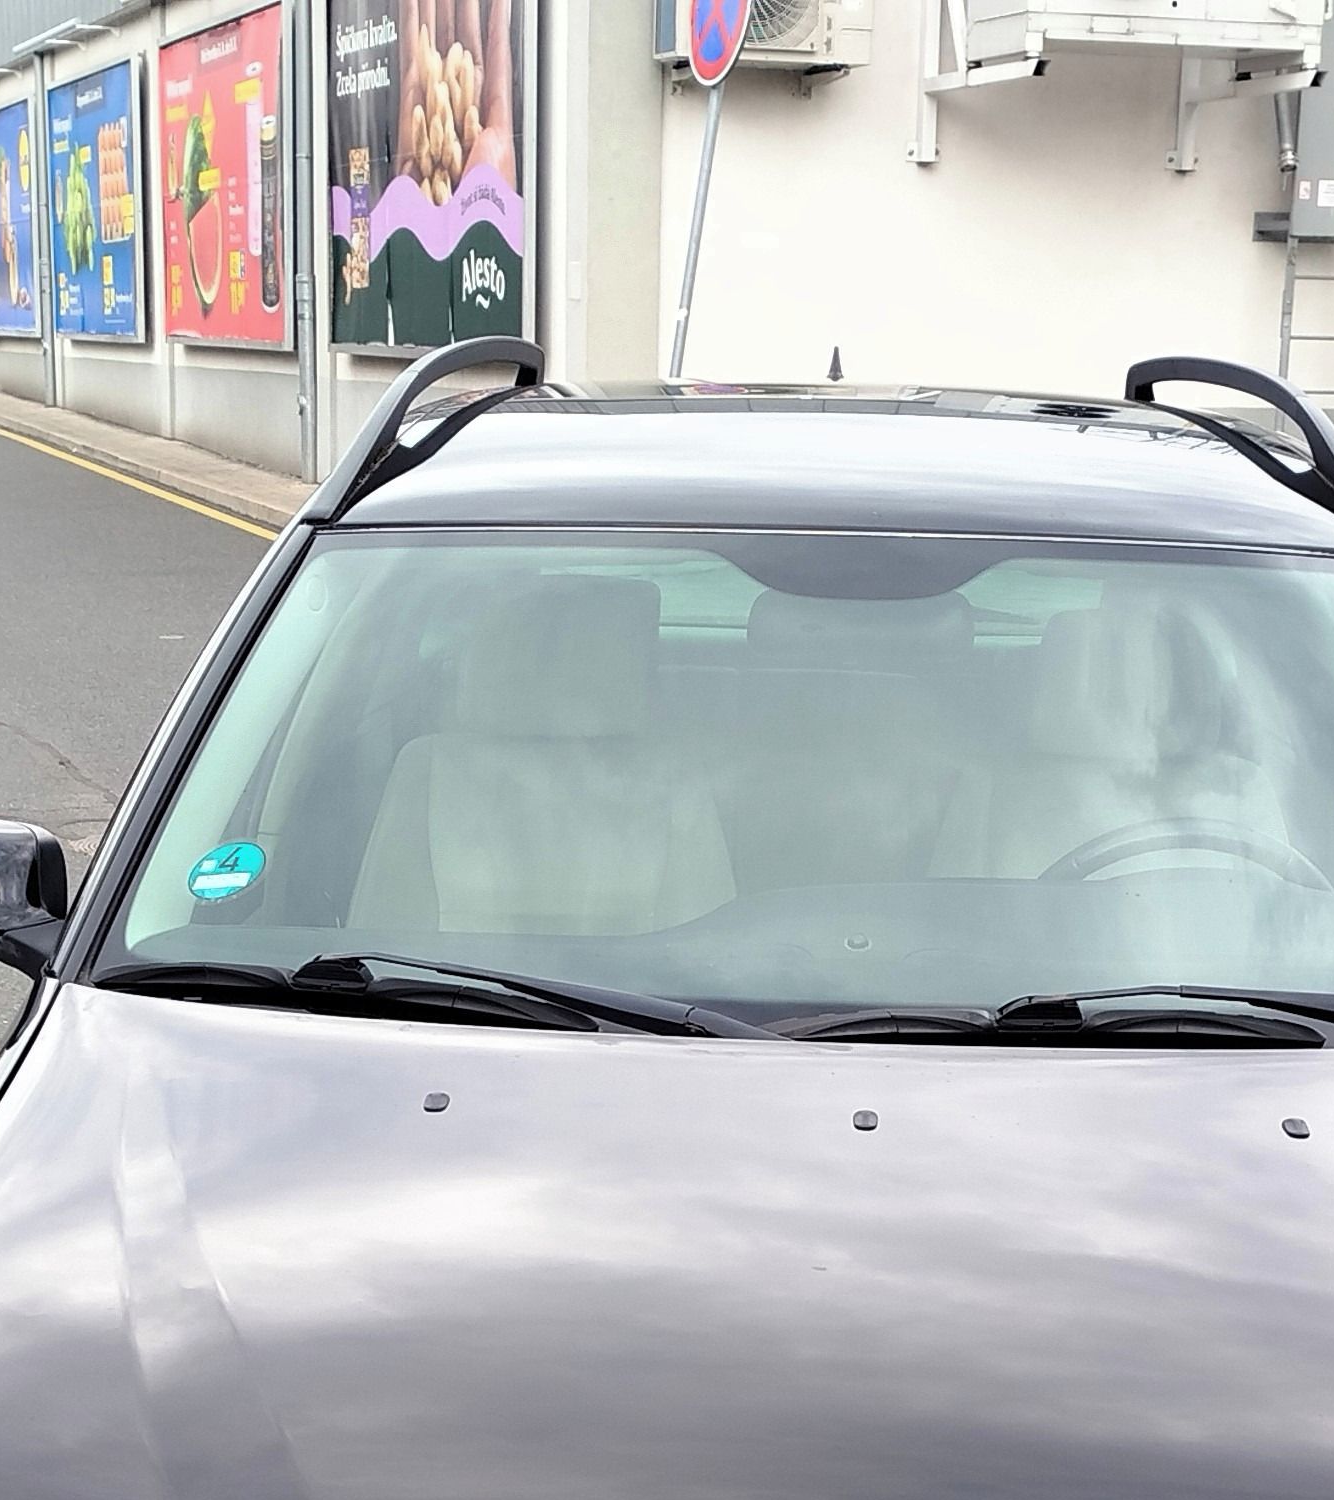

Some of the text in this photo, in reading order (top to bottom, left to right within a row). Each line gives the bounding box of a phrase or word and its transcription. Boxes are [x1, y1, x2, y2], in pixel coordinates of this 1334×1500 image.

[336, 66, 357, 97] Zcela
[462, 249, 505, 302] Alesto
[218, 846, 243, 871] 4
